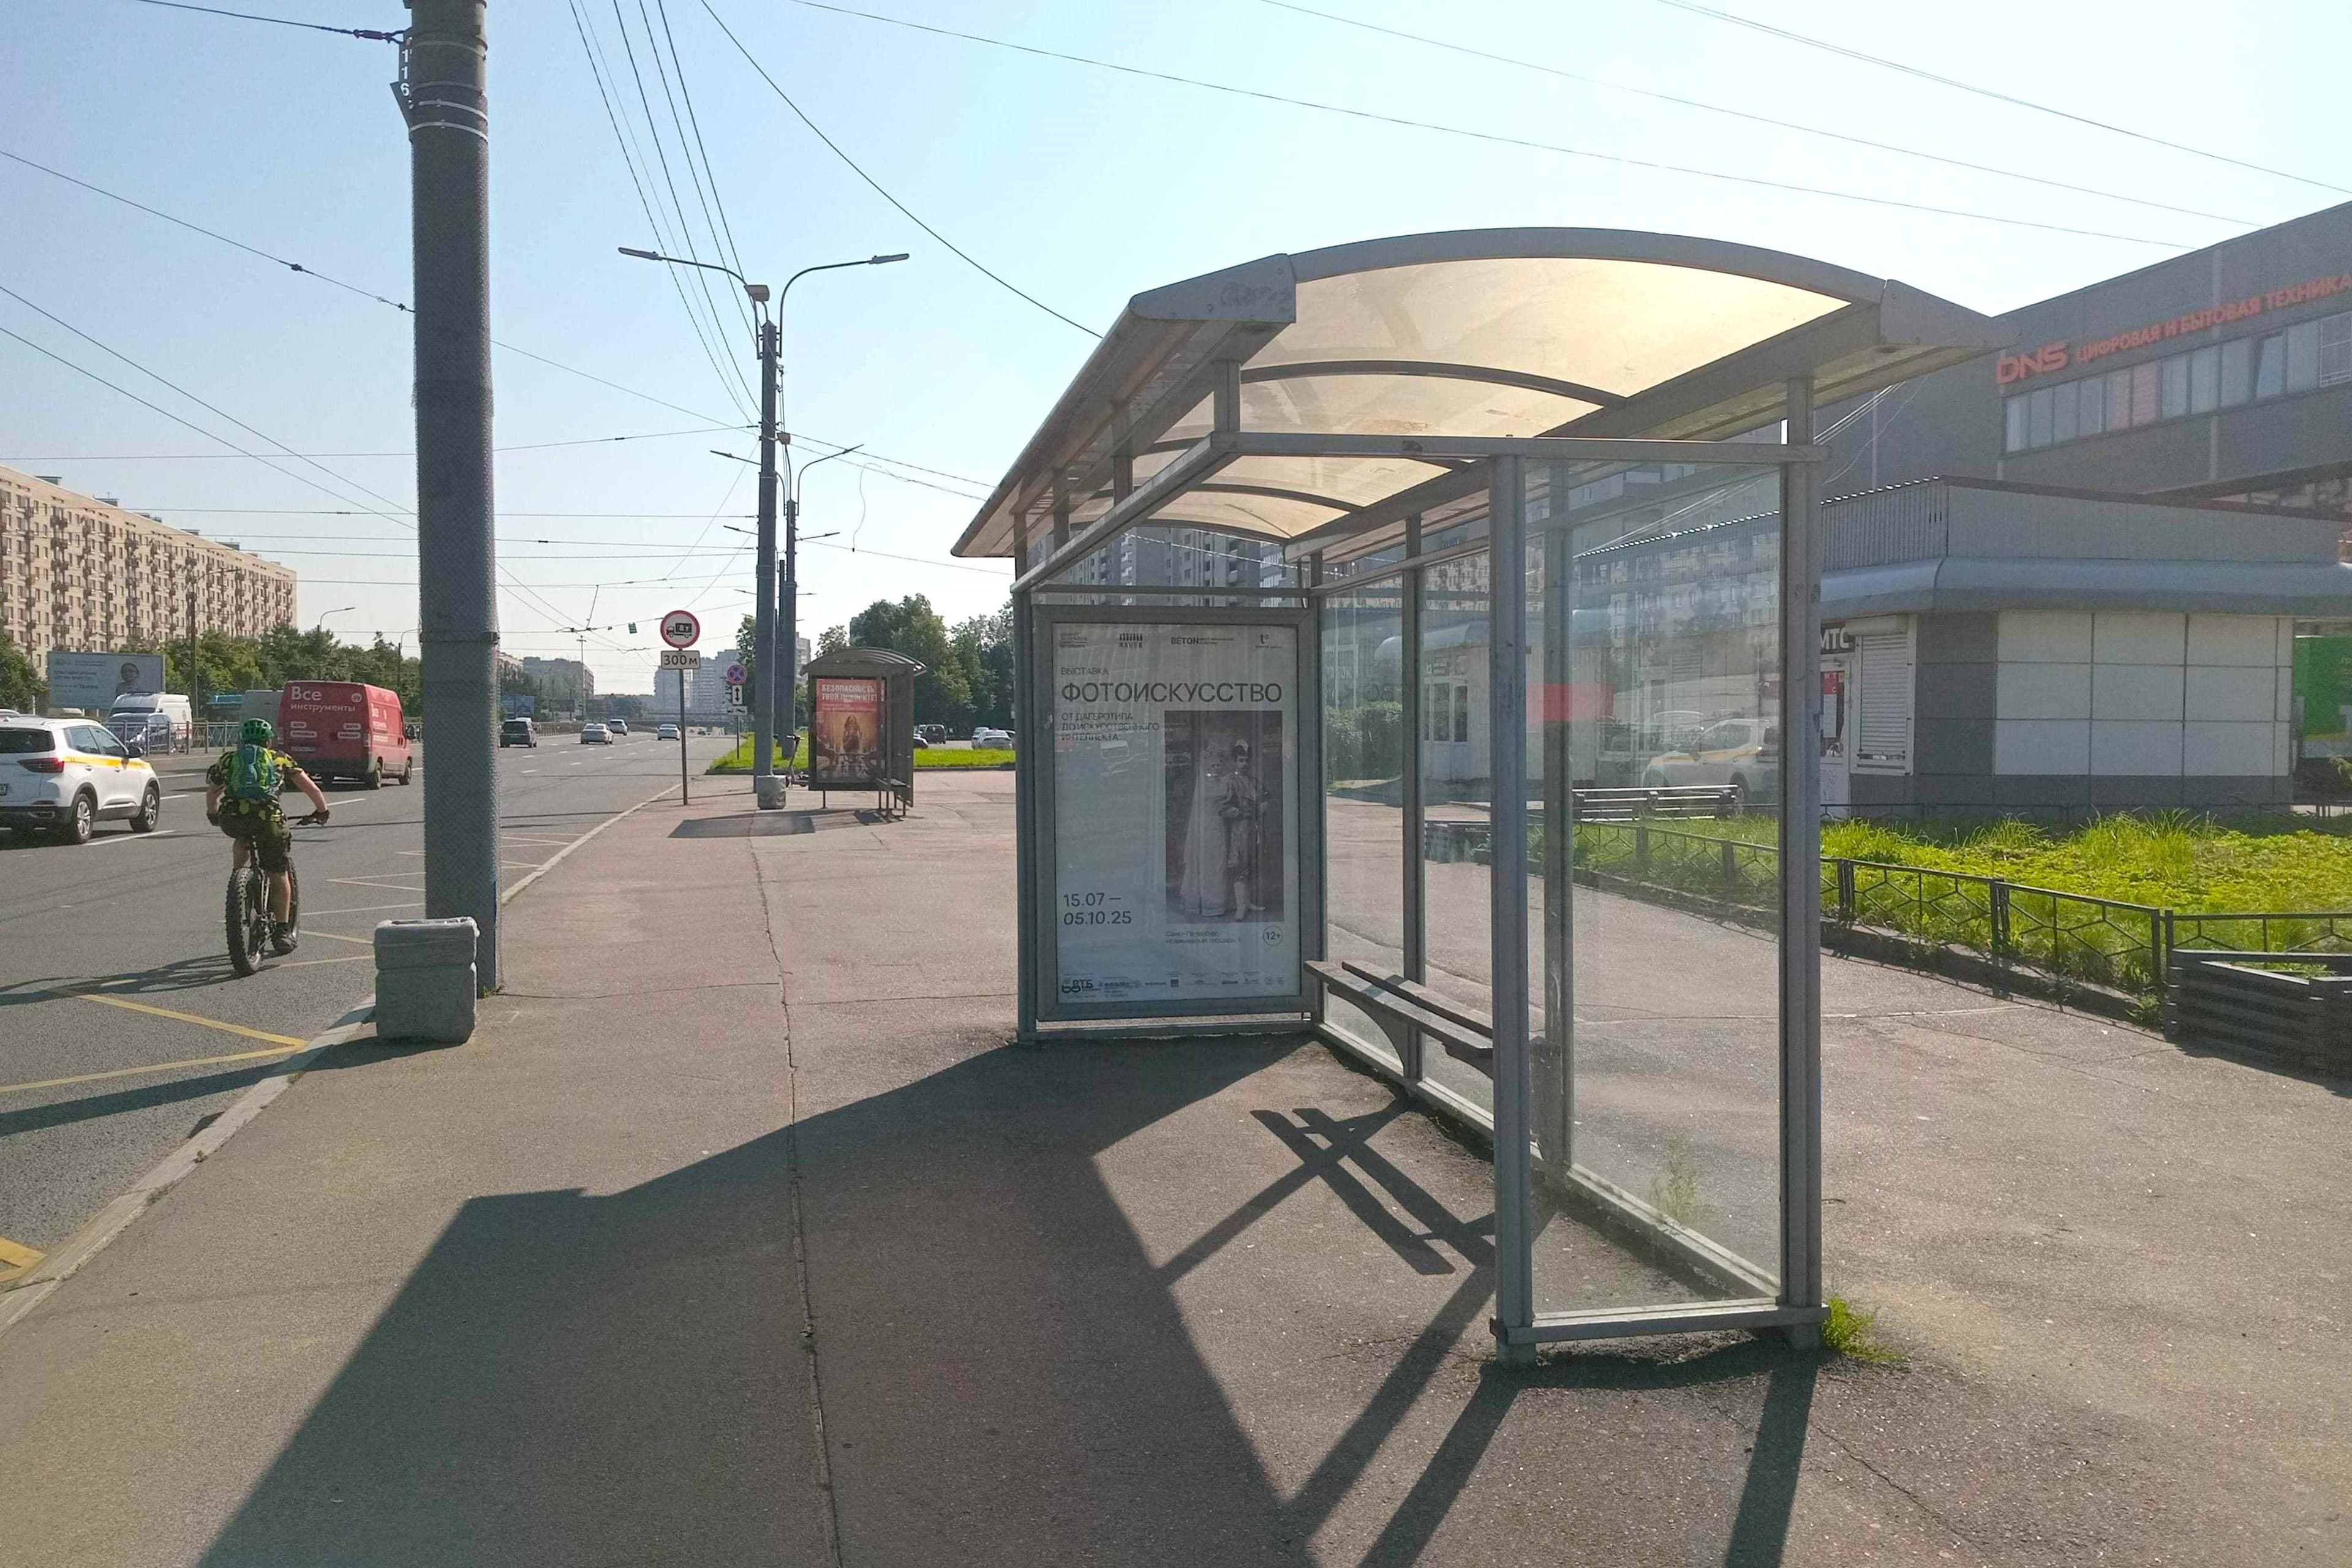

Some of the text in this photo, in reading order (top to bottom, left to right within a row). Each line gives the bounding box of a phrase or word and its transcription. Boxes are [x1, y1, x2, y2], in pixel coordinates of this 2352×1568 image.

[2078, 274, 2352, 362] ЦИФРОВАЯ И БЫТОВАЯ ТЕХНИКА
[1996, 344, 2068, 384] DNS
[663, 655, 687, 665] 300
[1061, 667, 1109, 676] ВЫСТАВКА
[291, 685, 322, 701] Все
[821, 684, 875, 693] БЕЗОПАСНОСТЬ
[1061, 682, 1282, 703] ФОТОИСКУССТВО
[290, 704, 355, 713] инструменты
[1061, 712, 1133, 721] ОТ ДАГЕРОТИПА
[1061, 722, 1159, 731] ДО ИСКУССТВЕННОГО
[1064, 892, 1105, 907] 15.07
[1063, 911, 1132, 925] 05.10.25
[1265, 932, 1281, 941] 12+
